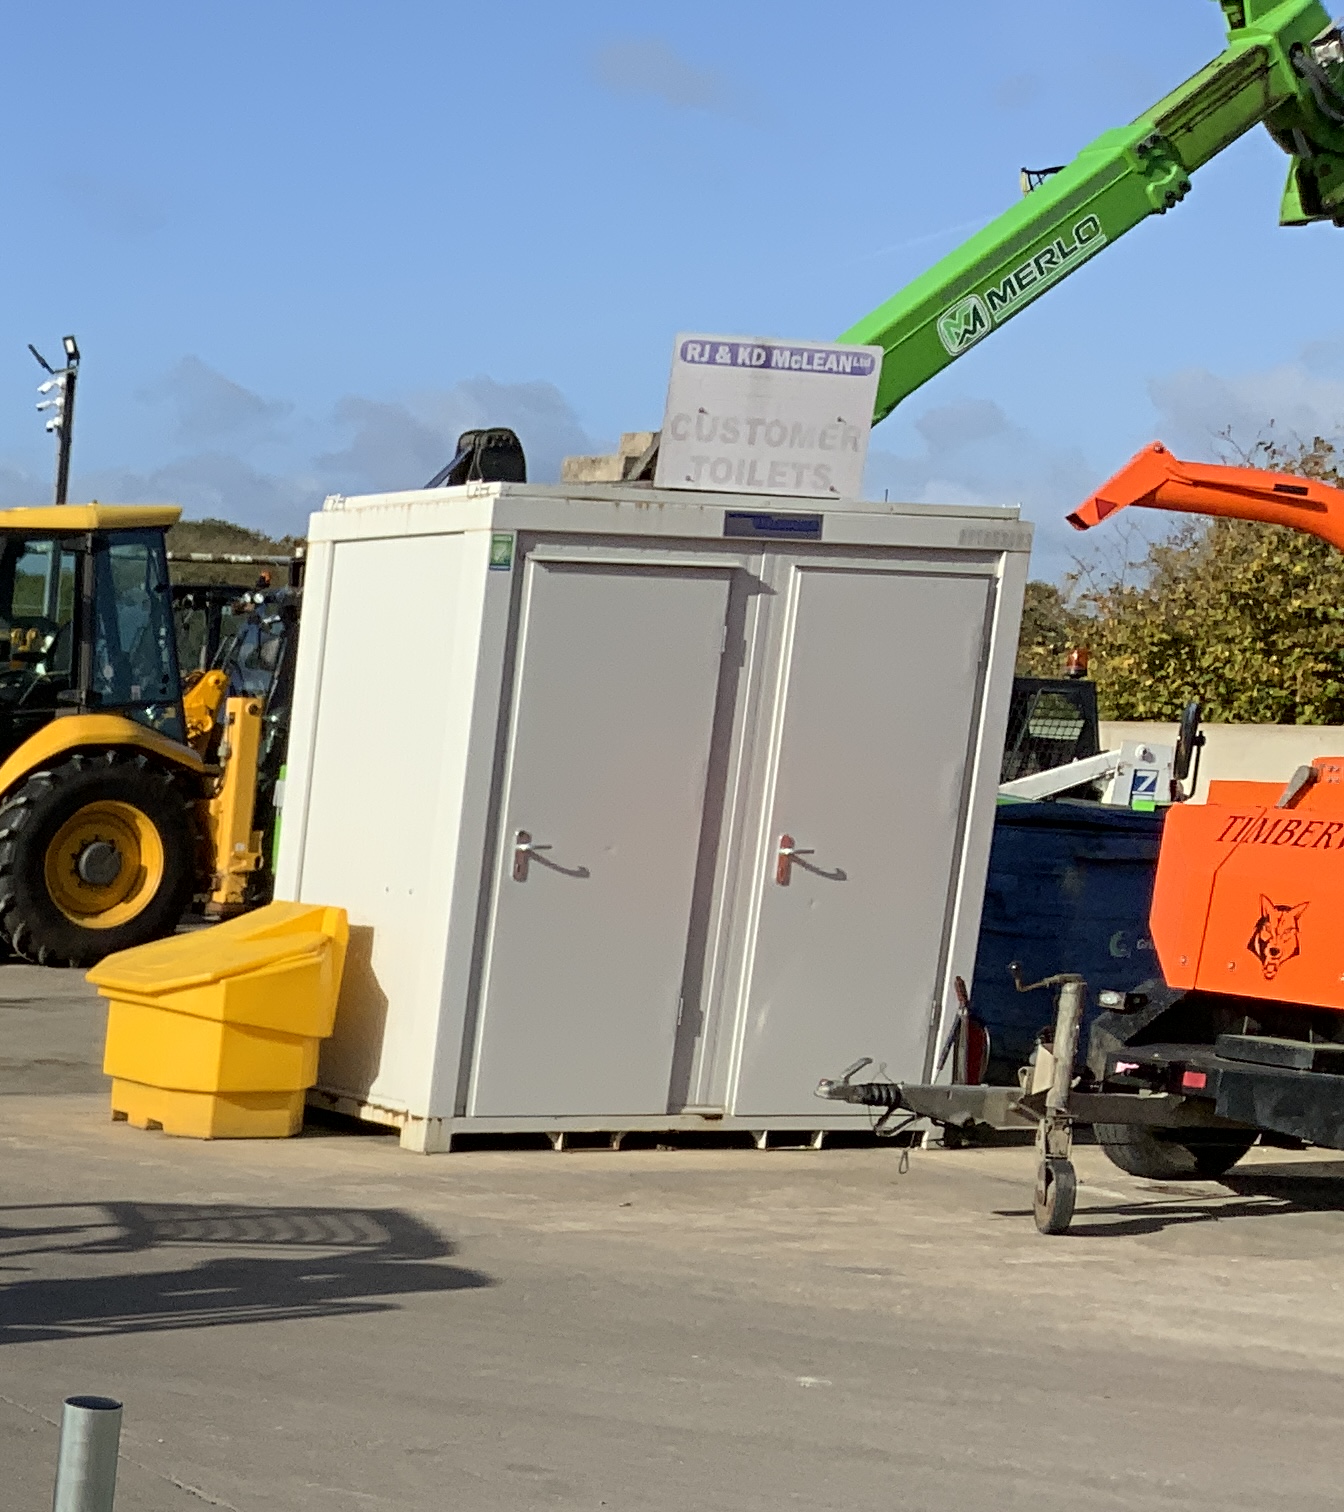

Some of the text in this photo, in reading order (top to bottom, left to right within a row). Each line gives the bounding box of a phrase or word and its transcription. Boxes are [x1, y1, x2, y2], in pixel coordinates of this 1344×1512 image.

[985, 214, 1101, 312] MERLO
[686, 343, 871, 373] RJ & KD McLEAN Ltd
[670, 412, 862, 452] CUSTOMER
[690, 455, 833, 490] TOILETS
[1216, 815, 1344, 850] TIMBER
